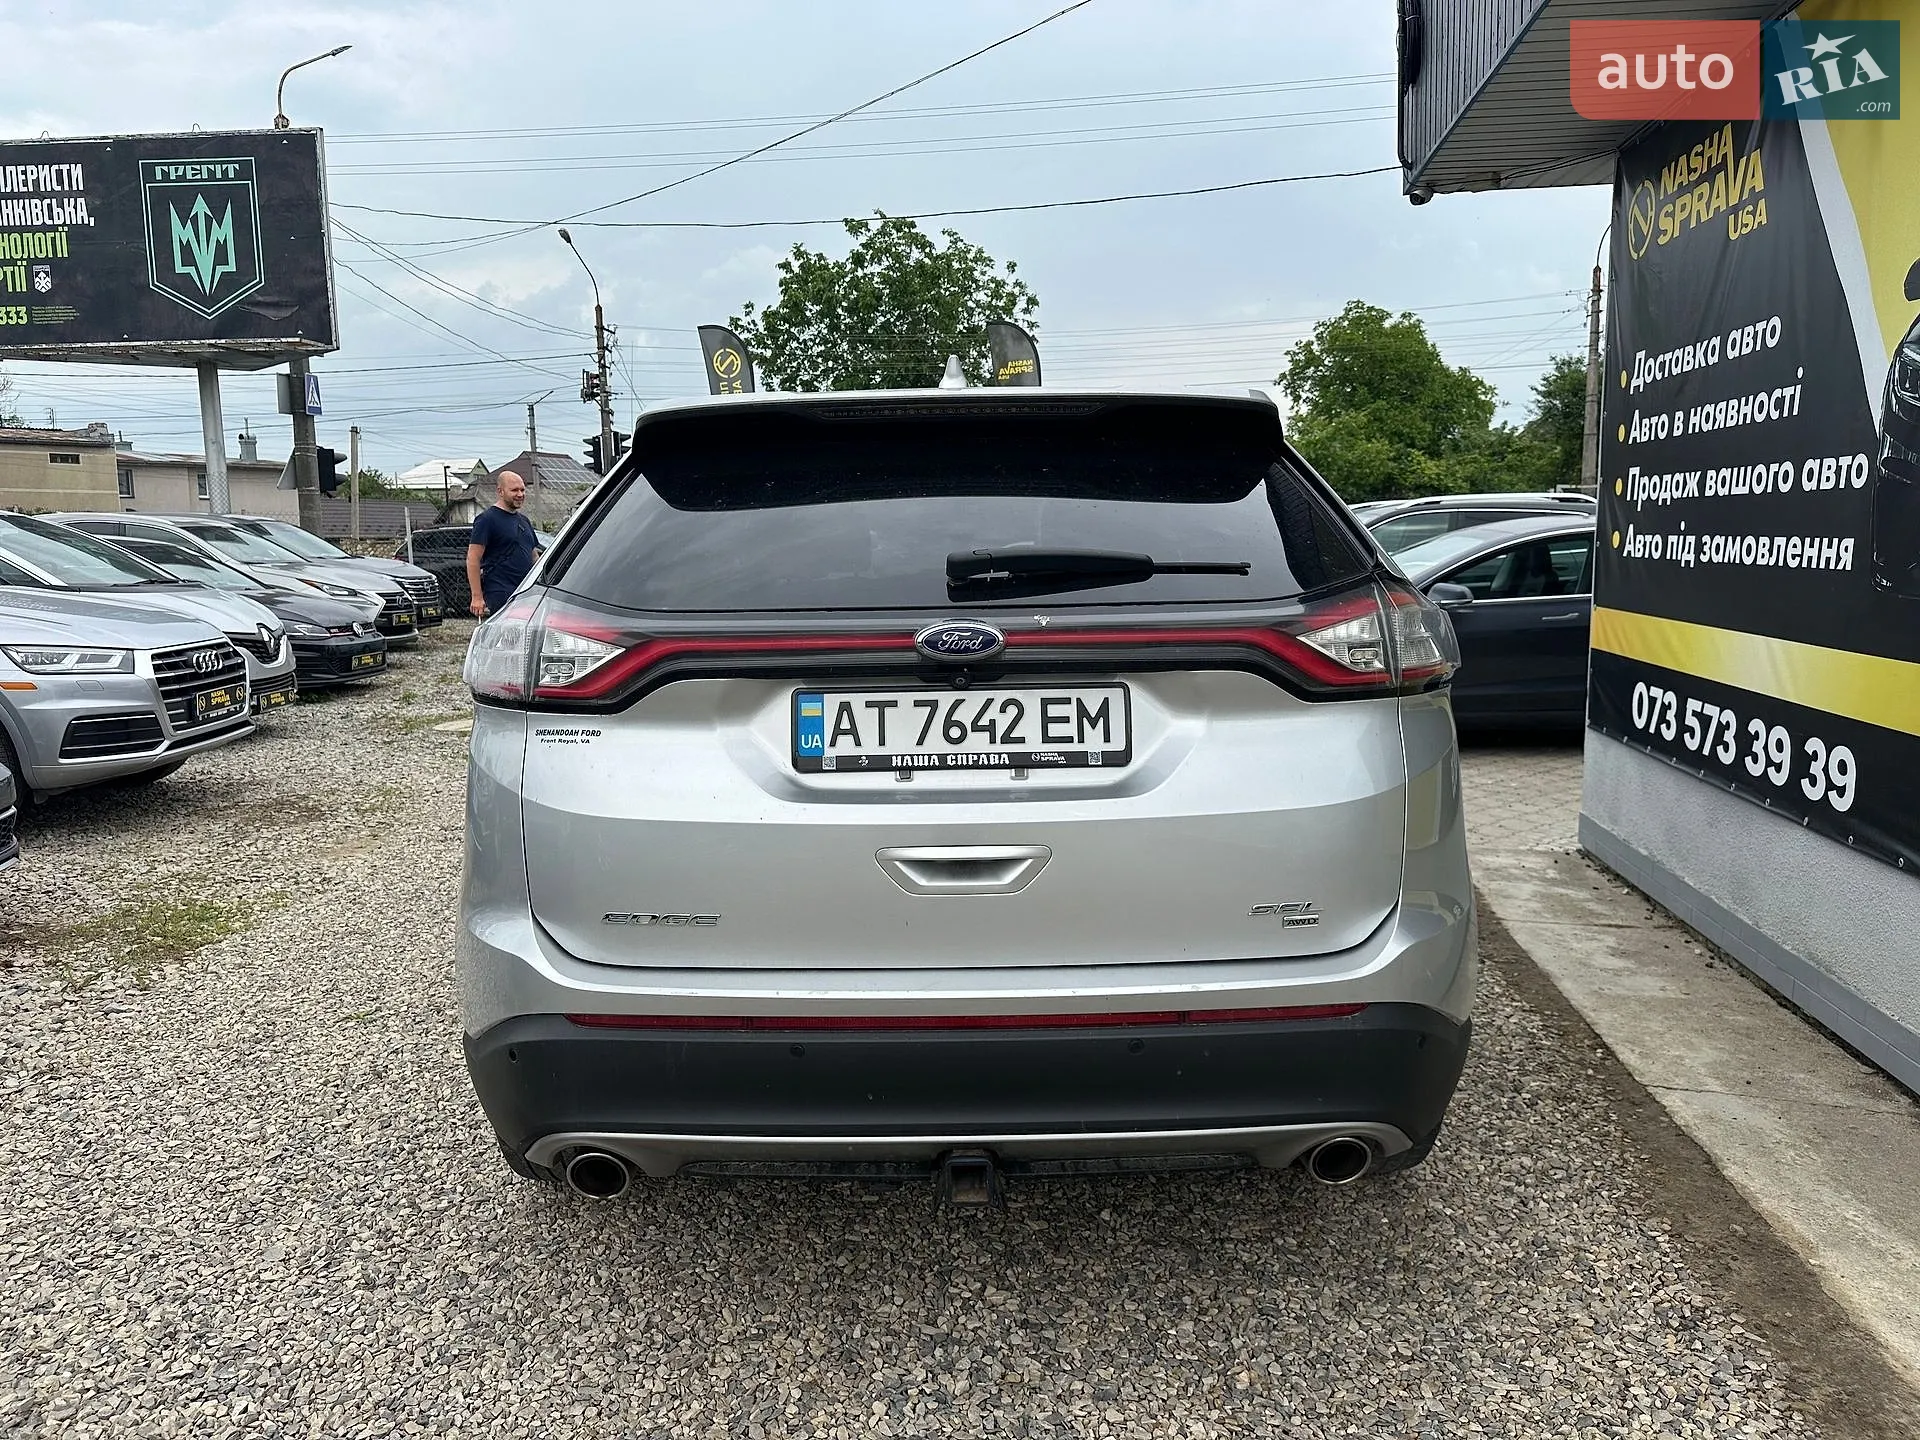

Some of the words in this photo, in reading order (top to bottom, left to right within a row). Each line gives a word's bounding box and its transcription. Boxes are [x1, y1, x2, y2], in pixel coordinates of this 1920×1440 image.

[1659, 122, 1733, 200] NASHA
[0, 197, 95, 227] НКІВСЬКА,
[1656, 148, 1765, 246] SPRAVA
[1728, 199, 1768, 240] USA
[1629, 334, 1721, 394] Доставка
[1726, 315, 1782, 360] авто
[1628, 410, 1668, 445] Авто
[1672, 416, 1684, 437] в
[1688, 367, 1805, 434] наявності
[1626, 467, 1700, 511] Продаж
[1704, 460, 1794, 497] вашого
[1801, 453, 1869, 492] авто
[1623, 524, 1662, 559] Авто
[1666, 520, 1695, 568] під
[1699, 534, 1855, 571] замовлення
[938, 631, 983, 650] Ford
[535, 728, 579, 737] SHENANDOAH
[580, 729, 602, 737] FORD
[801, 734, 822, 748] UA
[829, 700, 898, 747] AT
[913, 698, 1026, 746] 7642
[1040, 697, 1111, 744] EM
[891, 755, 940, 767] НАША
[946, 753, 1010, 766] СПРАВА
[1632, 681, 1677, 741] 073
[1683, 697, 1738, 765] 573
[1744, 718, 1792, 786] 39
[1801, 737, 1856, 812] 39
[601, 911, 722, 926] EDGE
[1286, 917, 1319, 927] AWD
